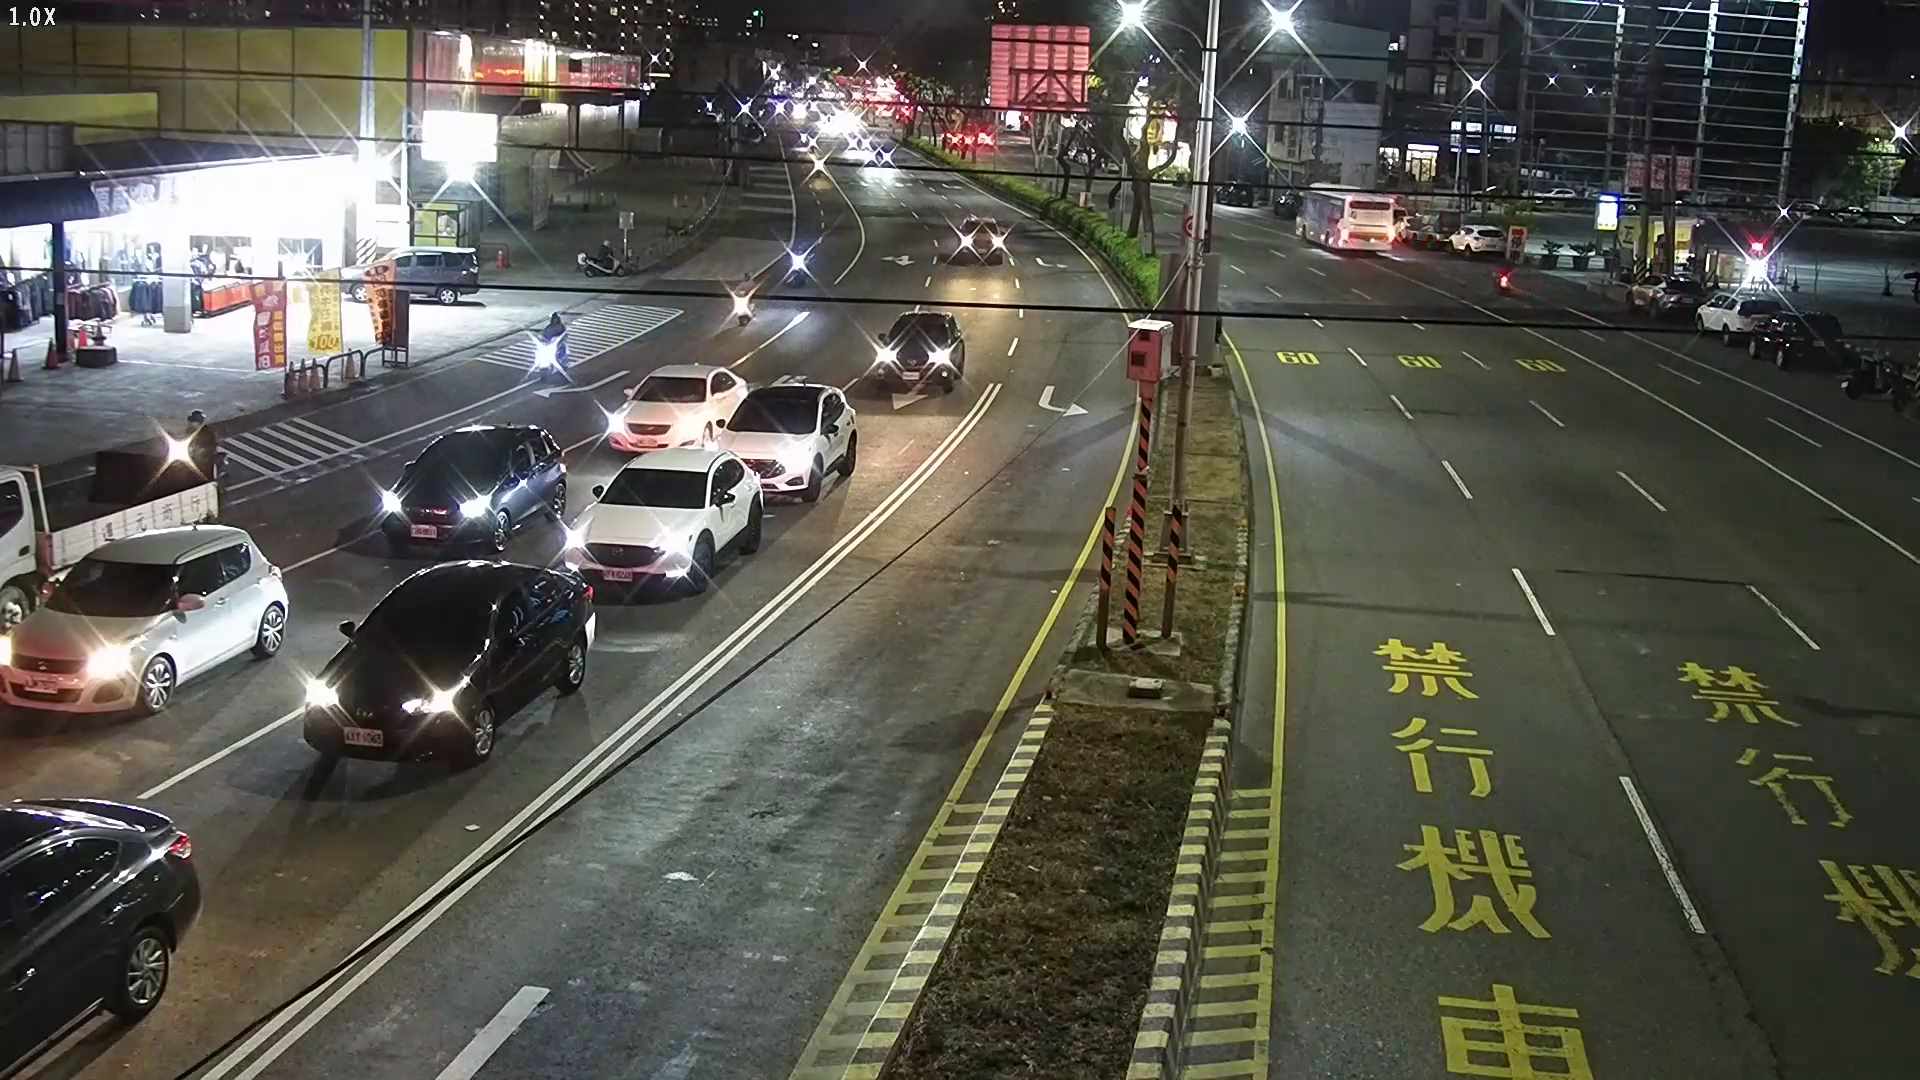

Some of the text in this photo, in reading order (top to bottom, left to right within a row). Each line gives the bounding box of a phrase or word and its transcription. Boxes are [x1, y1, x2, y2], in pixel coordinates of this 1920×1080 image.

[1276, 351, 1321, 366] 60
[1397, 354, 1442, 369] 60
[1516, 358, 1567, 373] 60
